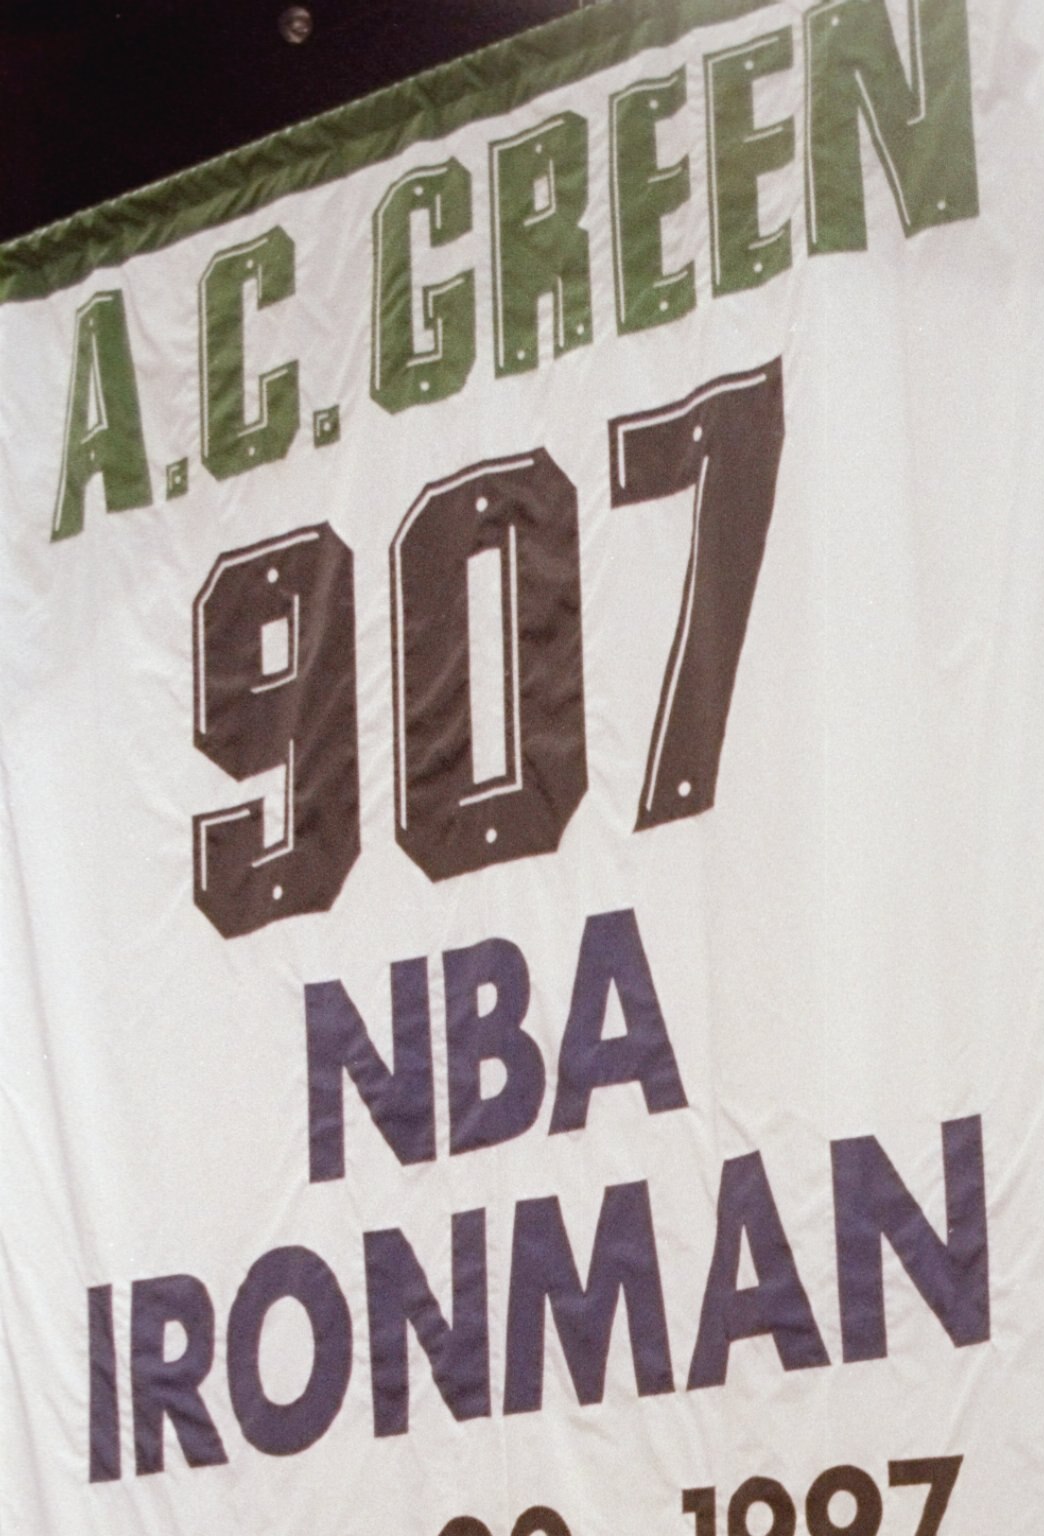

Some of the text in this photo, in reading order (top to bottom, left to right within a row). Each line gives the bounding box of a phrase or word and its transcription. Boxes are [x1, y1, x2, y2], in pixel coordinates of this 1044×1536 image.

[50, 0, 981, 543] A.C. GREEN
[193, 355, 786, 940] 907
[304, 907, 690, 1184] NBA
[88, 1113, 992, 1485] IRONMAN
